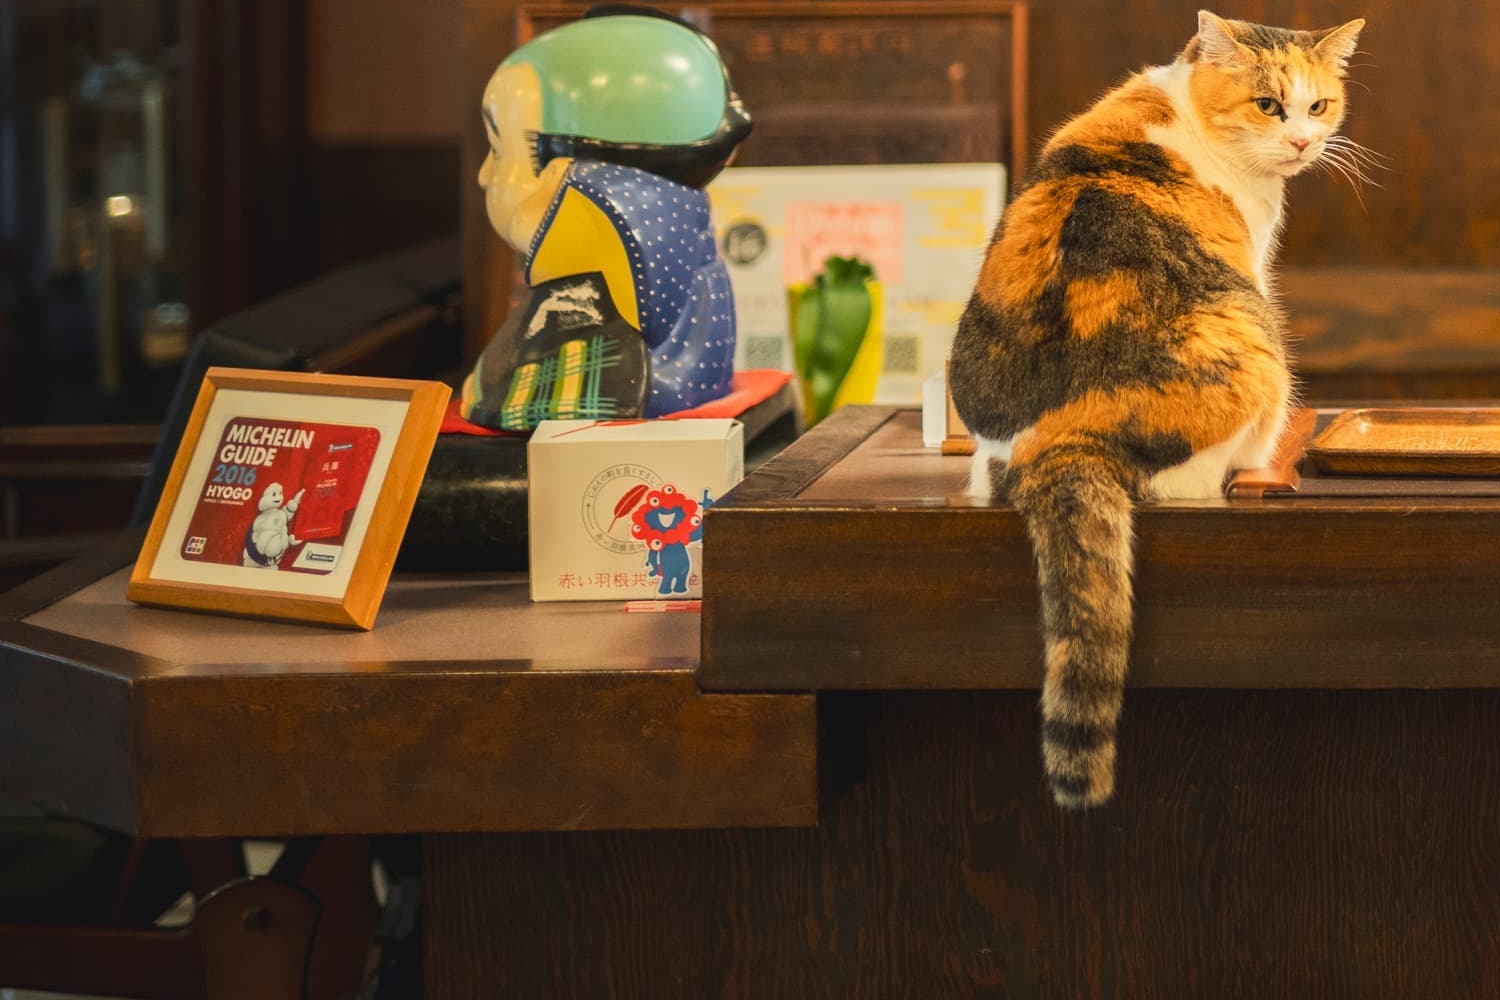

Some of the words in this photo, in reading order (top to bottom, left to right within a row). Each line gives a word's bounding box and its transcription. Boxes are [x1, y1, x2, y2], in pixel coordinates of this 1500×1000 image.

[226, 424, 315, 449] MICHELIN
[220, 444, 278, 467] GUIDE
[213, 464, 256, 486] 2016
[206, 485, 253, 500] HYOGO
